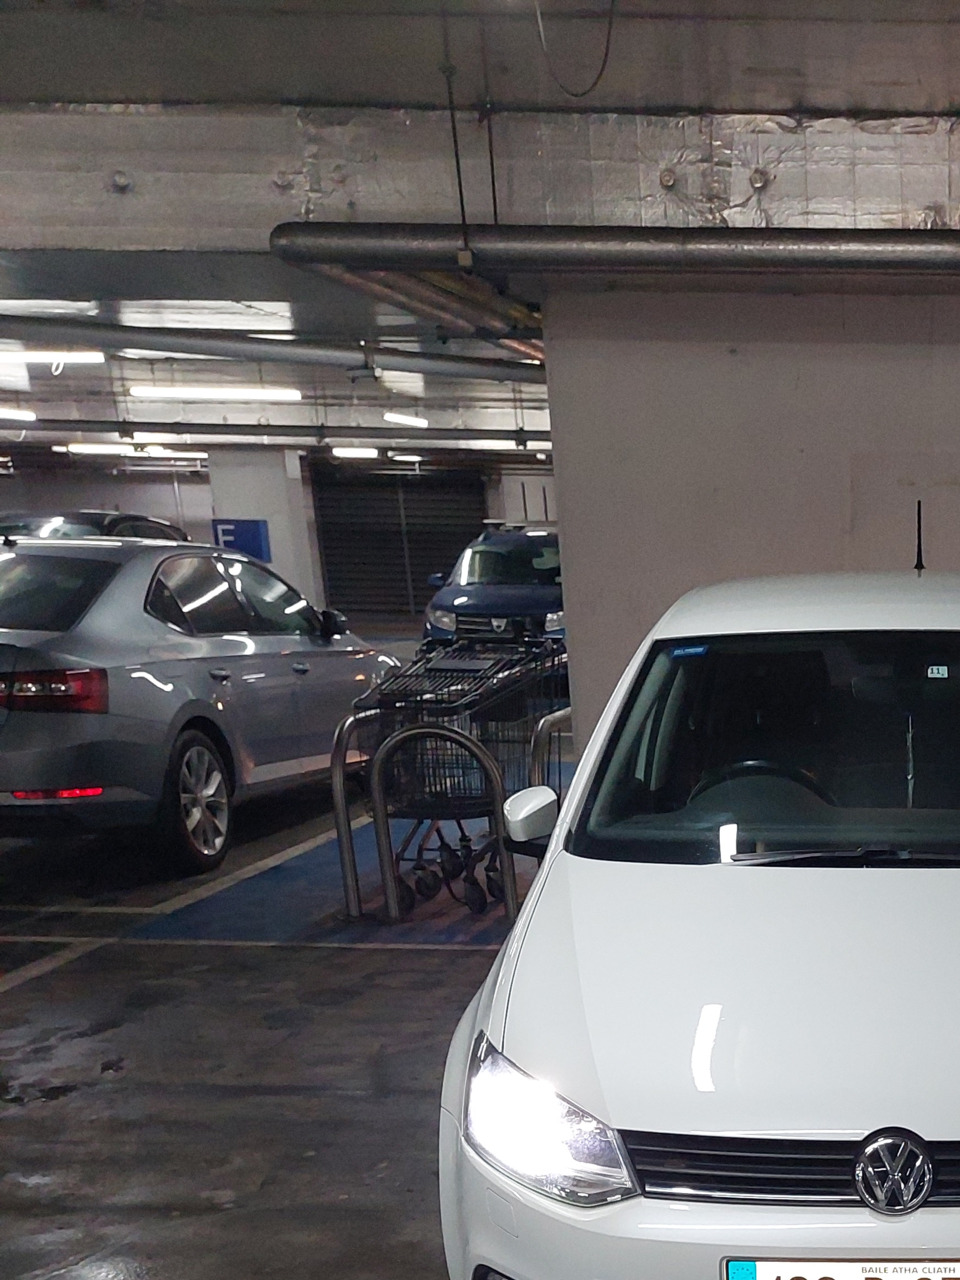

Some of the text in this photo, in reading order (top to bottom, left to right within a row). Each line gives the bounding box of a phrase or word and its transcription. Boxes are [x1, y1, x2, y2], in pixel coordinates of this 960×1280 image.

[861, 1266, 956, 1274] BAILE ATHA CLIATH
